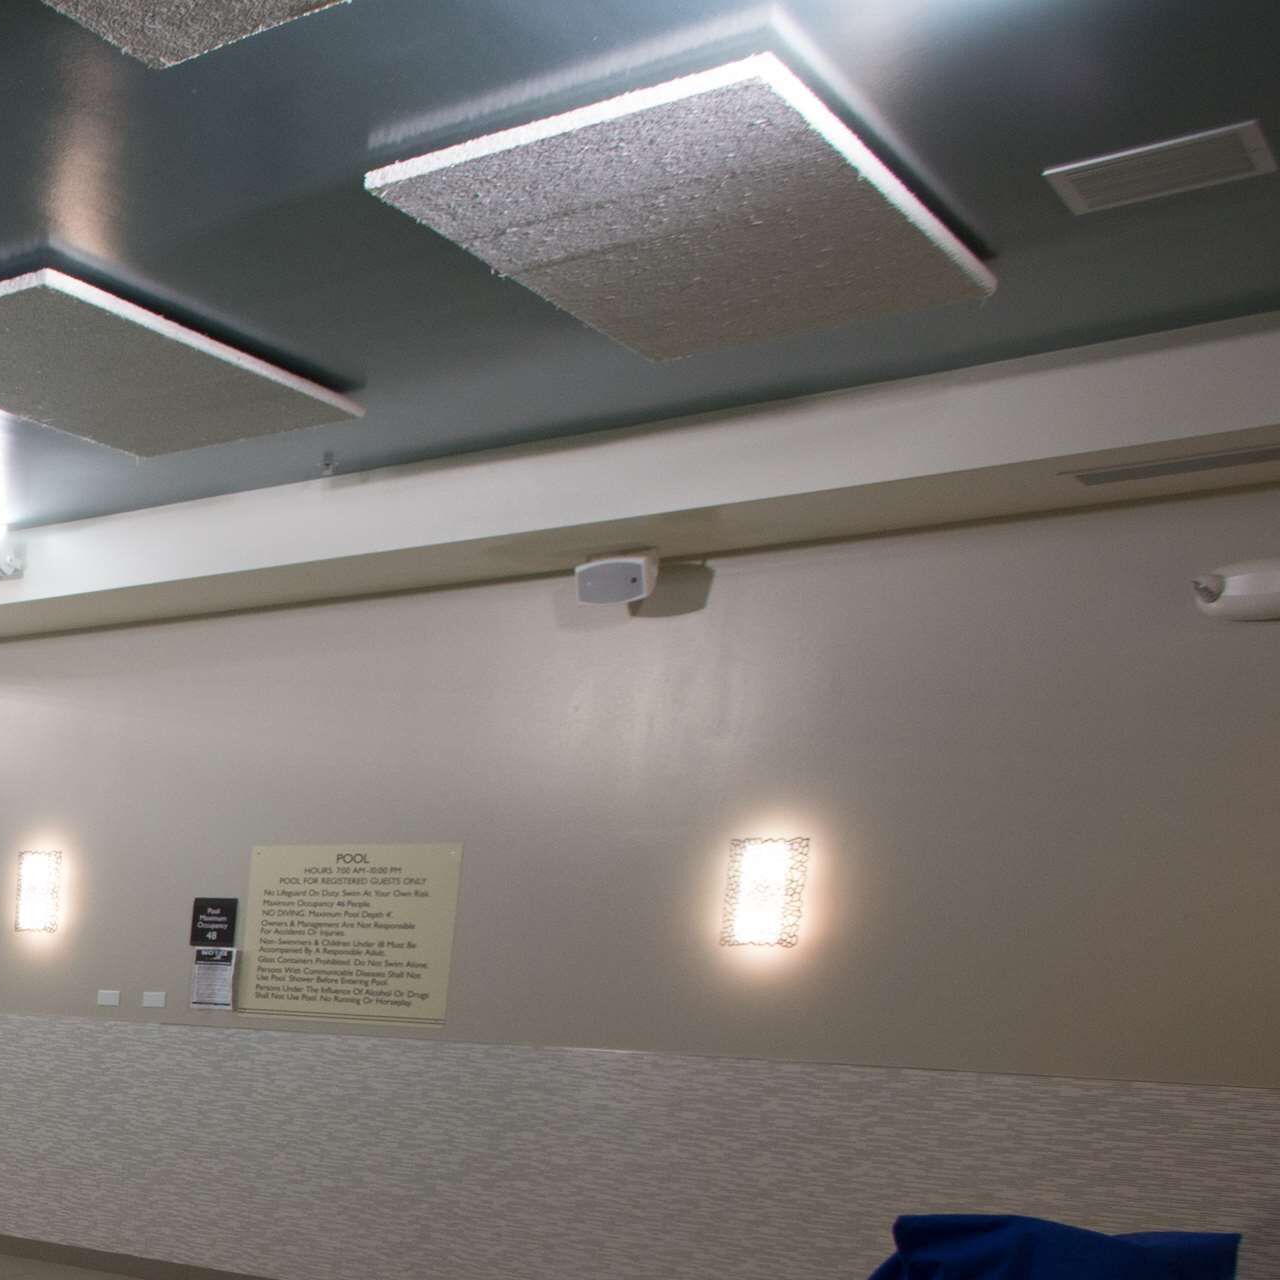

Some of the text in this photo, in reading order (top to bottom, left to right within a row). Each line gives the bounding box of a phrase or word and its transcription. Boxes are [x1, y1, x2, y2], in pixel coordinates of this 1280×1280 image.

[336, 853, 369, 864] POOL
[280, 877, 427, 886] POOL FOR REGISTERED GUESTS ONLY
